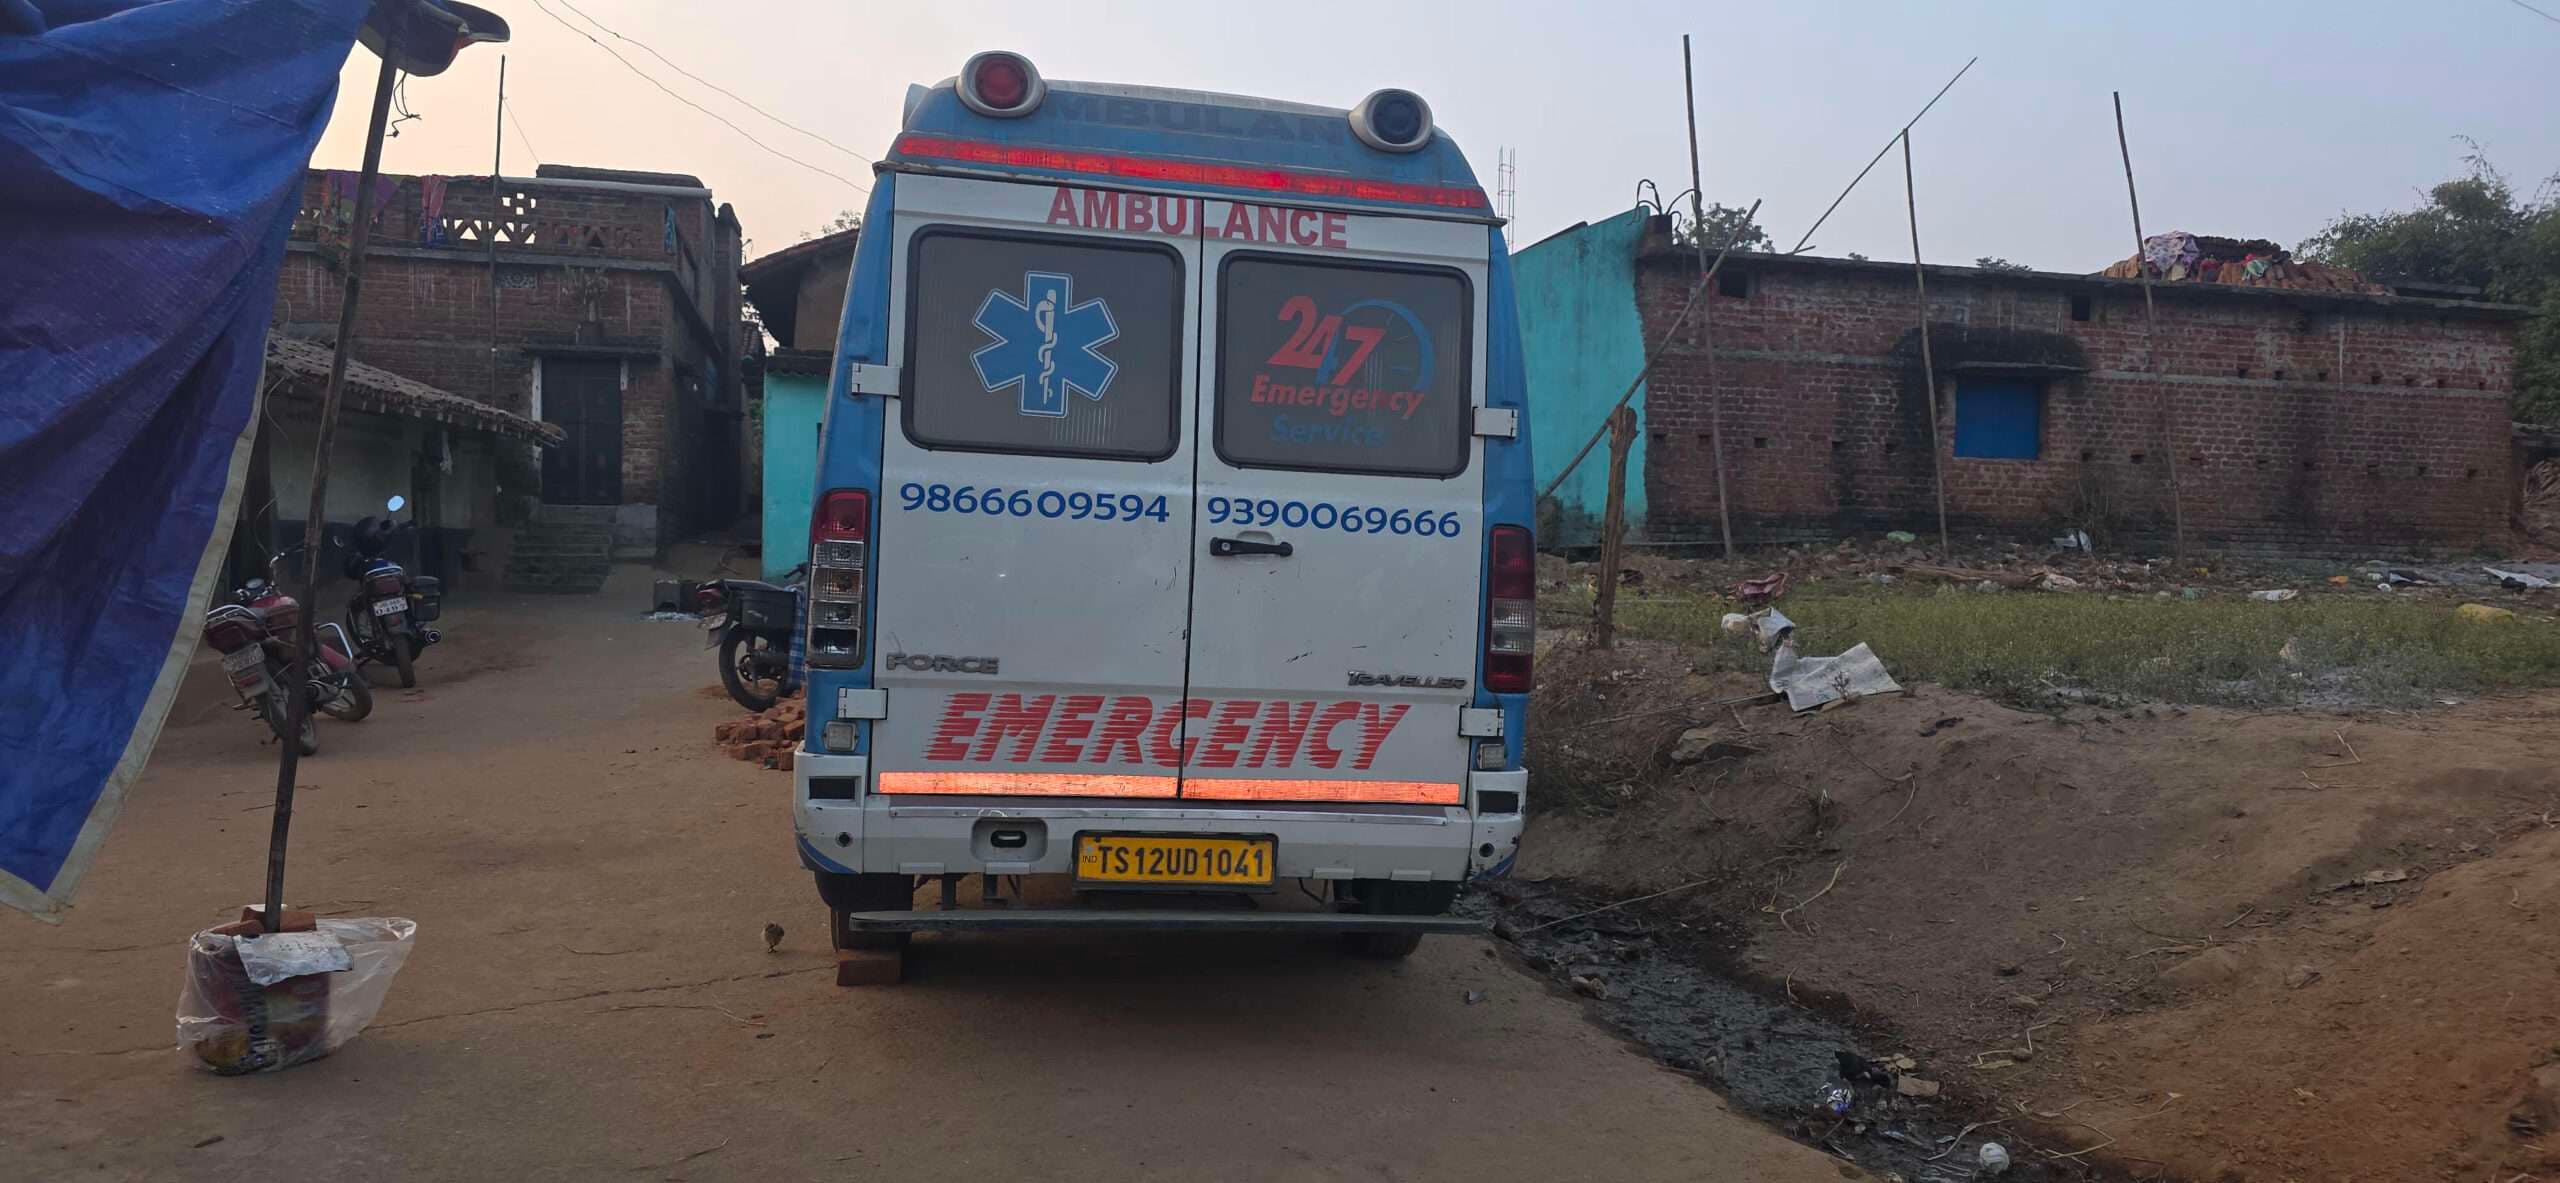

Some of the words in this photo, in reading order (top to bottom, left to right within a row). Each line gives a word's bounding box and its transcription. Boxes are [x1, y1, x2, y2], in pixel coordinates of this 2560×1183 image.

[1047, 187, 1348, 249] AMBULANCE
[1251, 373, 1425, 420] Emergency
[1271, 413, 1389, 447] Service
[900, 483, 1170, 522] 9866609594
[1207, 496, 1461, 538] 9390069666
[886, 652, 999, 675] FORCE
[1348, 670, 1467, 690] TRAVELLER
[922, 693, 1411, 770] EMERGENCY
[1098, 846, 1264, 877] TS12UD1041
